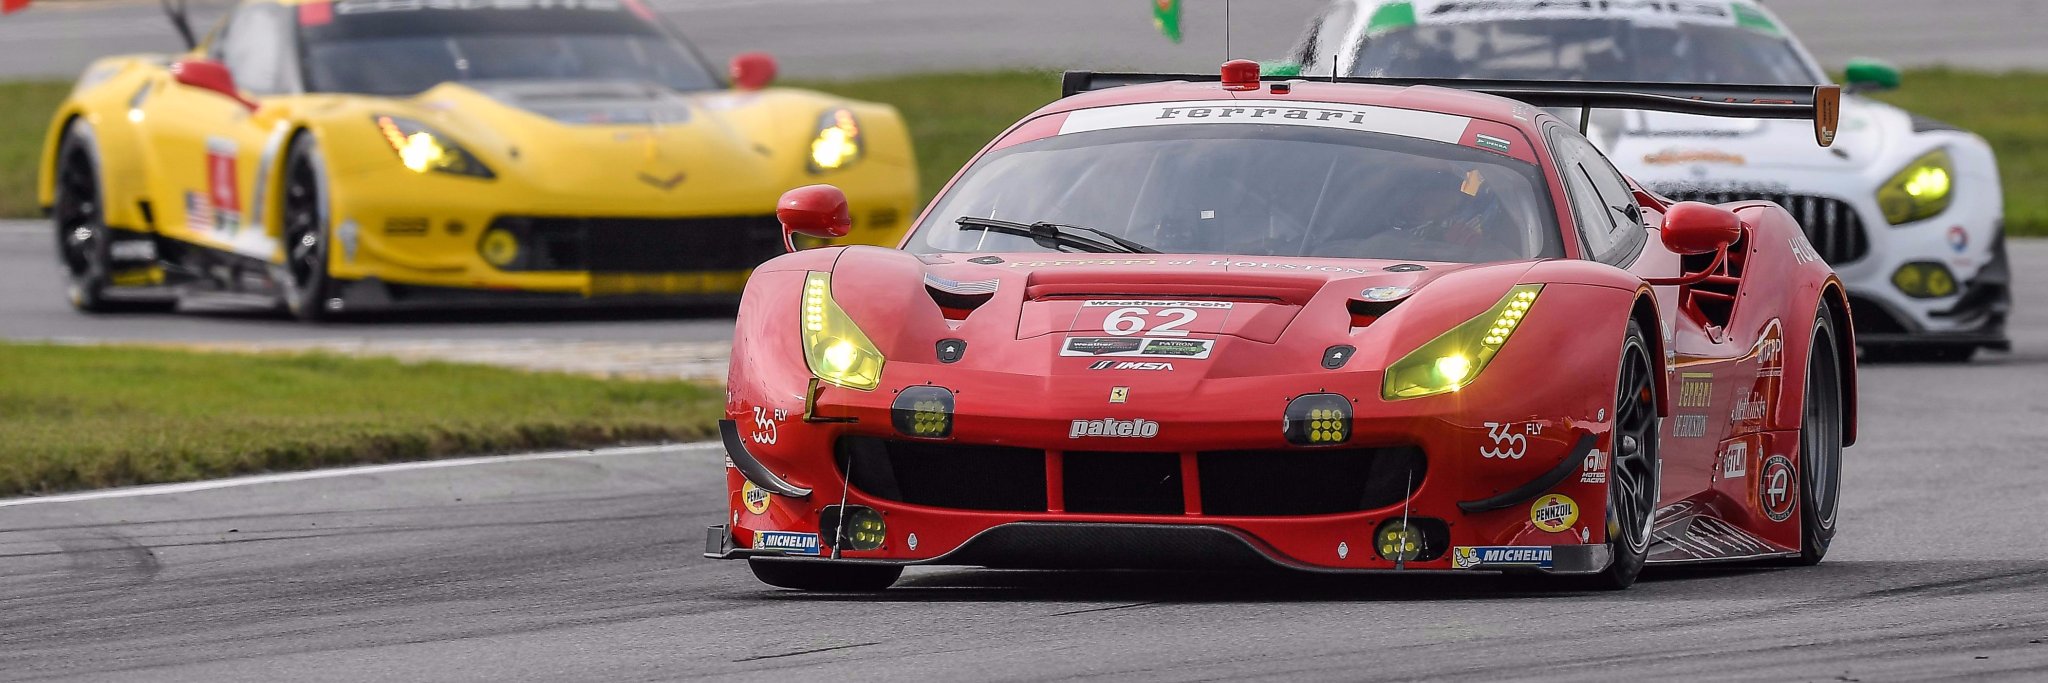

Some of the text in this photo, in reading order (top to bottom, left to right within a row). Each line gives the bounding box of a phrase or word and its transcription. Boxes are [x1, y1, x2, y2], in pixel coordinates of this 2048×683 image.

[1156, 105, 1366, 125] Ferrari
[1208, 260, 1368, 274] HOUSTON
[1091, 300, 1230, 308] WeatherTech
[1102, 307, 1198, 337] 62
[1114, 361, 1174, 371] IMSA
[1679, 373, 1713, 407] Ferrari
[752, 406, 788, 445] 360 FLY
[1069, 418, 1159, 438] pakelo
[1480, 422, 1543, 460] 360 FLY
[1535, 503, 1573, 522] PENNZOIL
[765, 535, 816, 548] MICHELIN
[1484, 549, 1553, 562] MICHELIN
